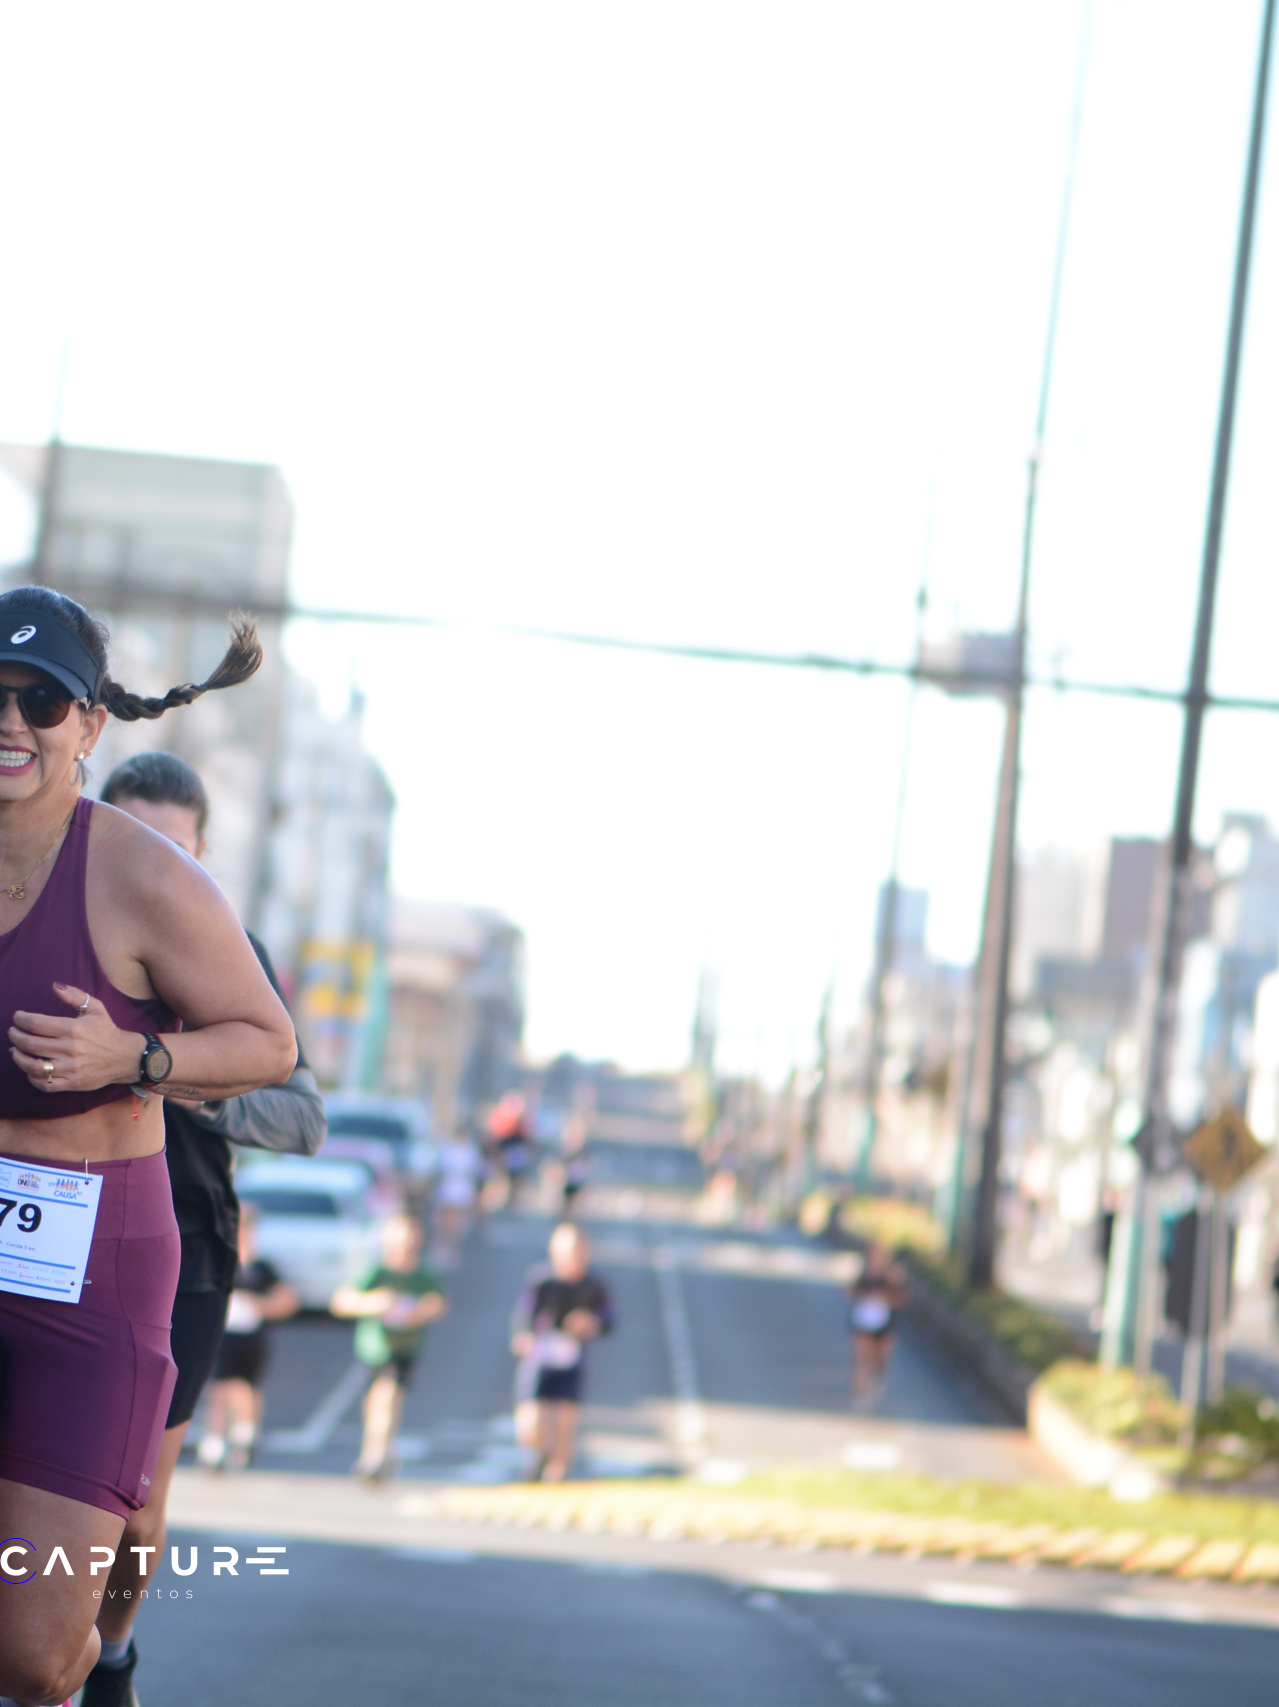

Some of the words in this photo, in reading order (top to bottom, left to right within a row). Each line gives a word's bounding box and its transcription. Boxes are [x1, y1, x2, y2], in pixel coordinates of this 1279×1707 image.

[17, 1179, 31, 1187] ONG
[54, 1190, 77, 1200] CAUSA
[6, 1241, 23, 1249] Corrida
